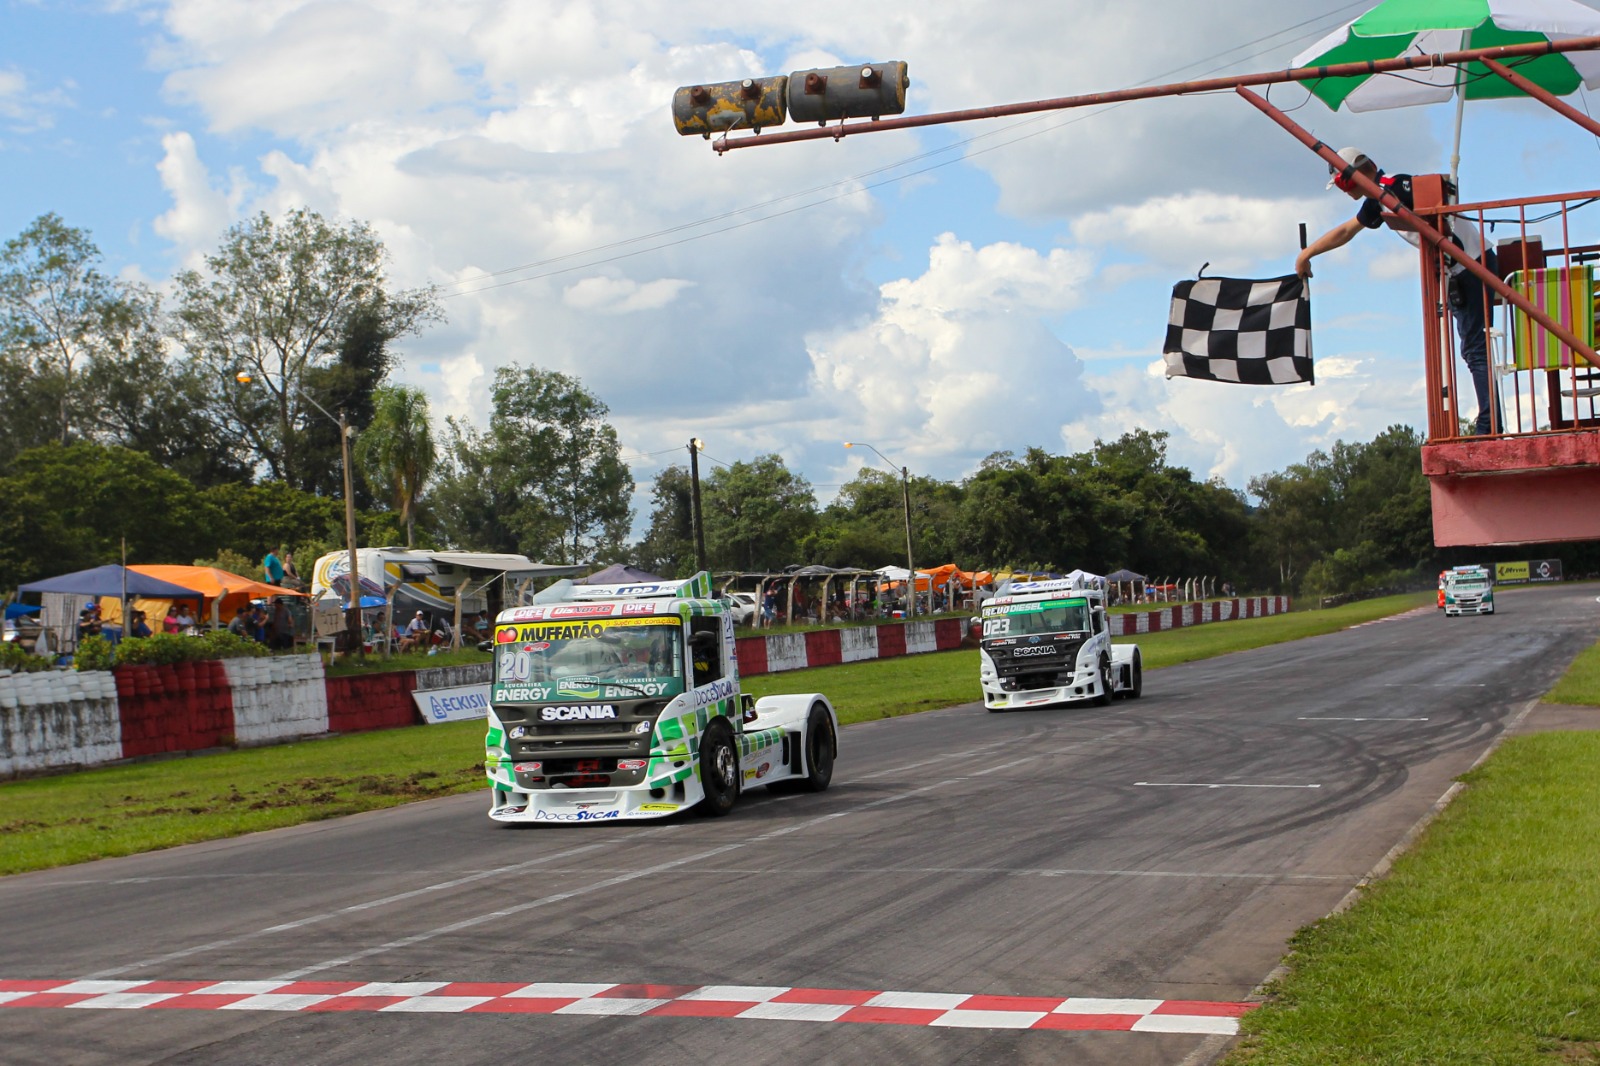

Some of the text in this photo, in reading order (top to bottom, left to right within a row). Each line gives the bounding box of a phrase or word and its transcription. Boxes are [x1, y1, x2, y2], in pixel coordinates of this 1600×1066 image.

[622, 587, 654, 595] LDP
[626, 603, 654, 611] DIFE
[520, 622, 603, 642] MUFFATÃO
[1013, 645, 1057, 658] SCANIA
[499, 652, 531, 682] 20
[495, 687, 552, 702] ENERGY
[605, 683, 668, 698] ENERGY
[541, 704, 616, 721] SCANIA
